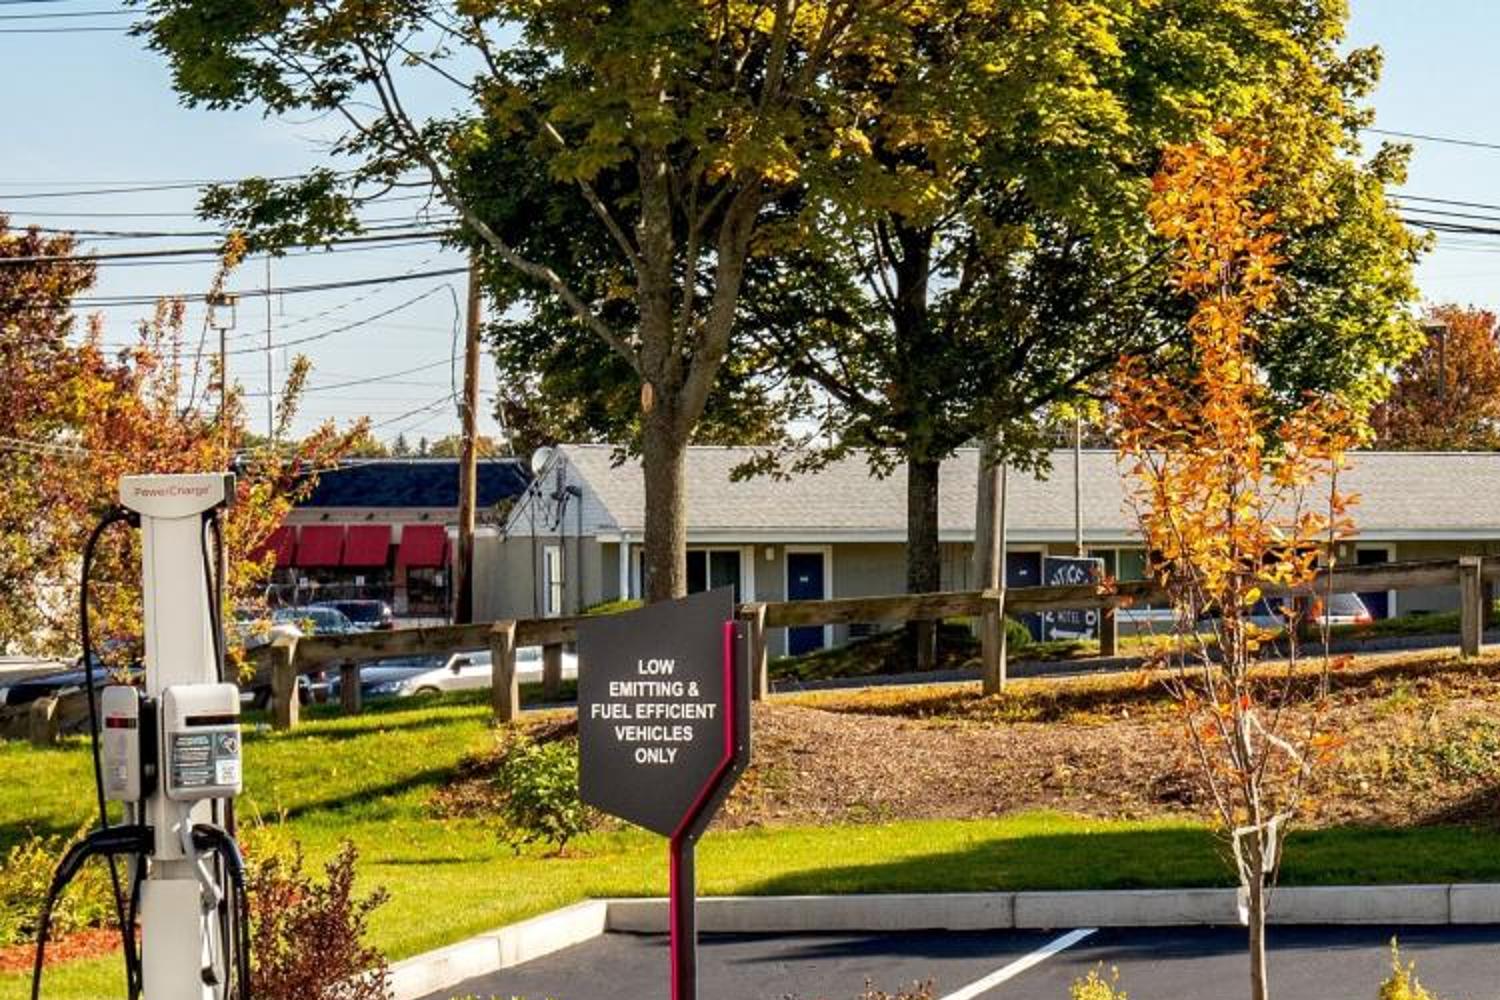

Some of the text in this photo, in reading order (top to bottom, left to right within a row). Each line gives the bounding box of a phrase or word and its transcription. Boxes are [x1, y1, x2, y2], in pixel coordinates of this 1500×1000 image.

[638, 659, 675, 675] LOW
[609, 681, 699, 697] EMITTING &
[591, 703, 717, 719] FUEL EFFICIENT
[615, 726, 693, 741] VEHICLES
[635, 747, 677, 763] ONLY
